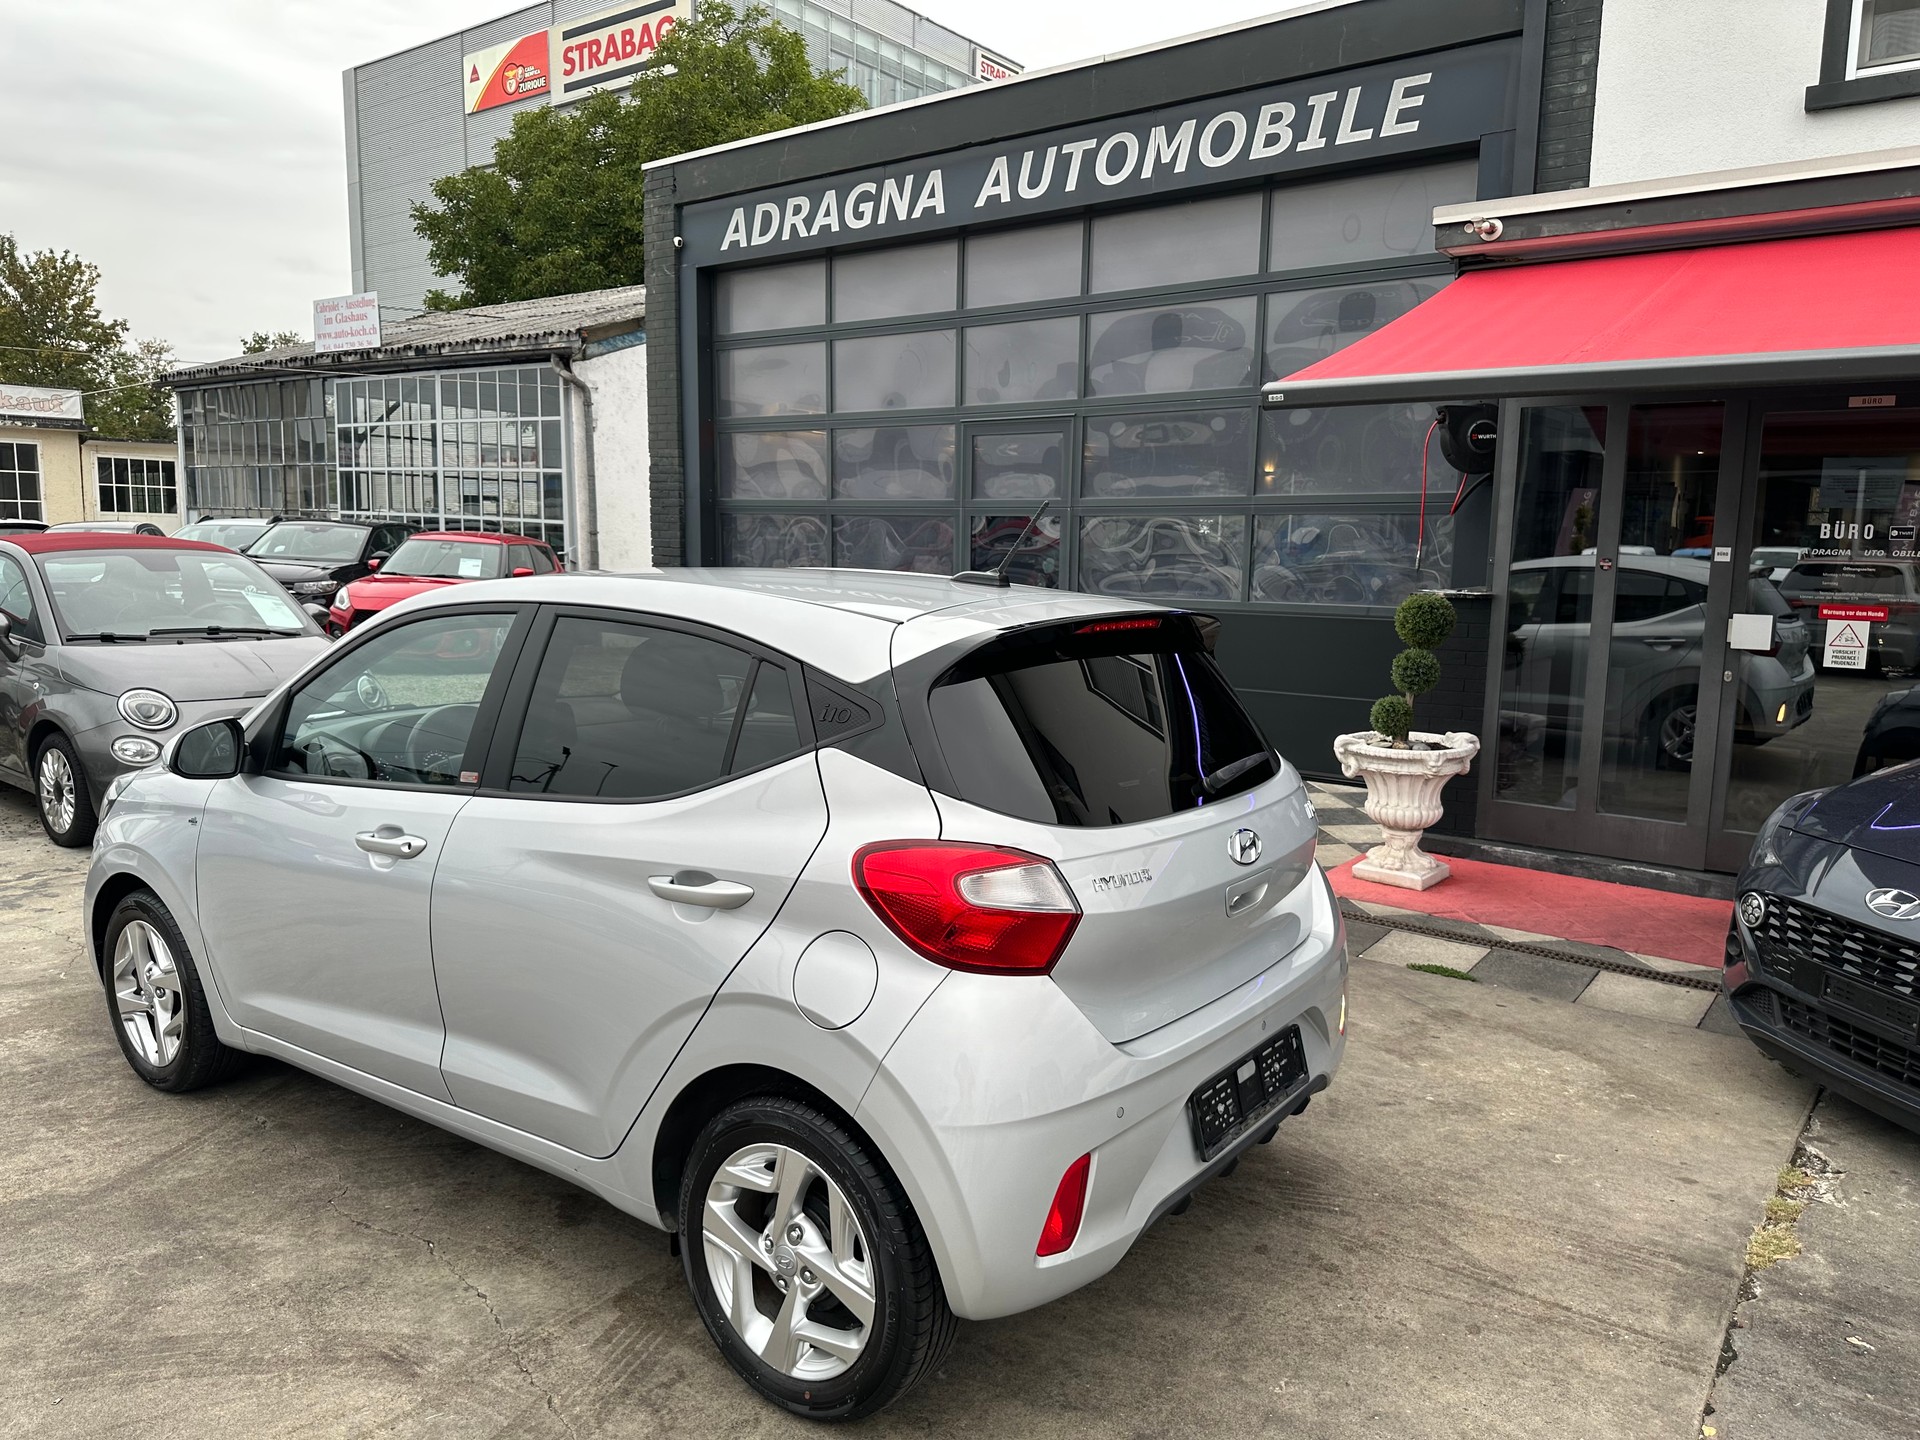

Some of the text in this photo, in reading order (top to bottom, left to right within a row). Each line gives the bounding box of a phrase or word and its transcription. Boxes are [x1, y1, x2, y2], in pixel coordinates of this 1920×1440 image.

[518, 76, 546, 93] ZURIQUE
[720, 72, 1433, 251] ADRAGNA AUTOMOBILE
[315, 301, 340, 314] Cabriolet
[345, 297, 376, 309] Ausstellung
[324, 312, 368, 325] im Glashaus
[316, 324, 377, 340] www.auto-koch.ch
[1819, 520, 1875, 540] BÜRO
[1822, 608, 1846, 616] Warnung
[819, 703, 852, 724] i10
